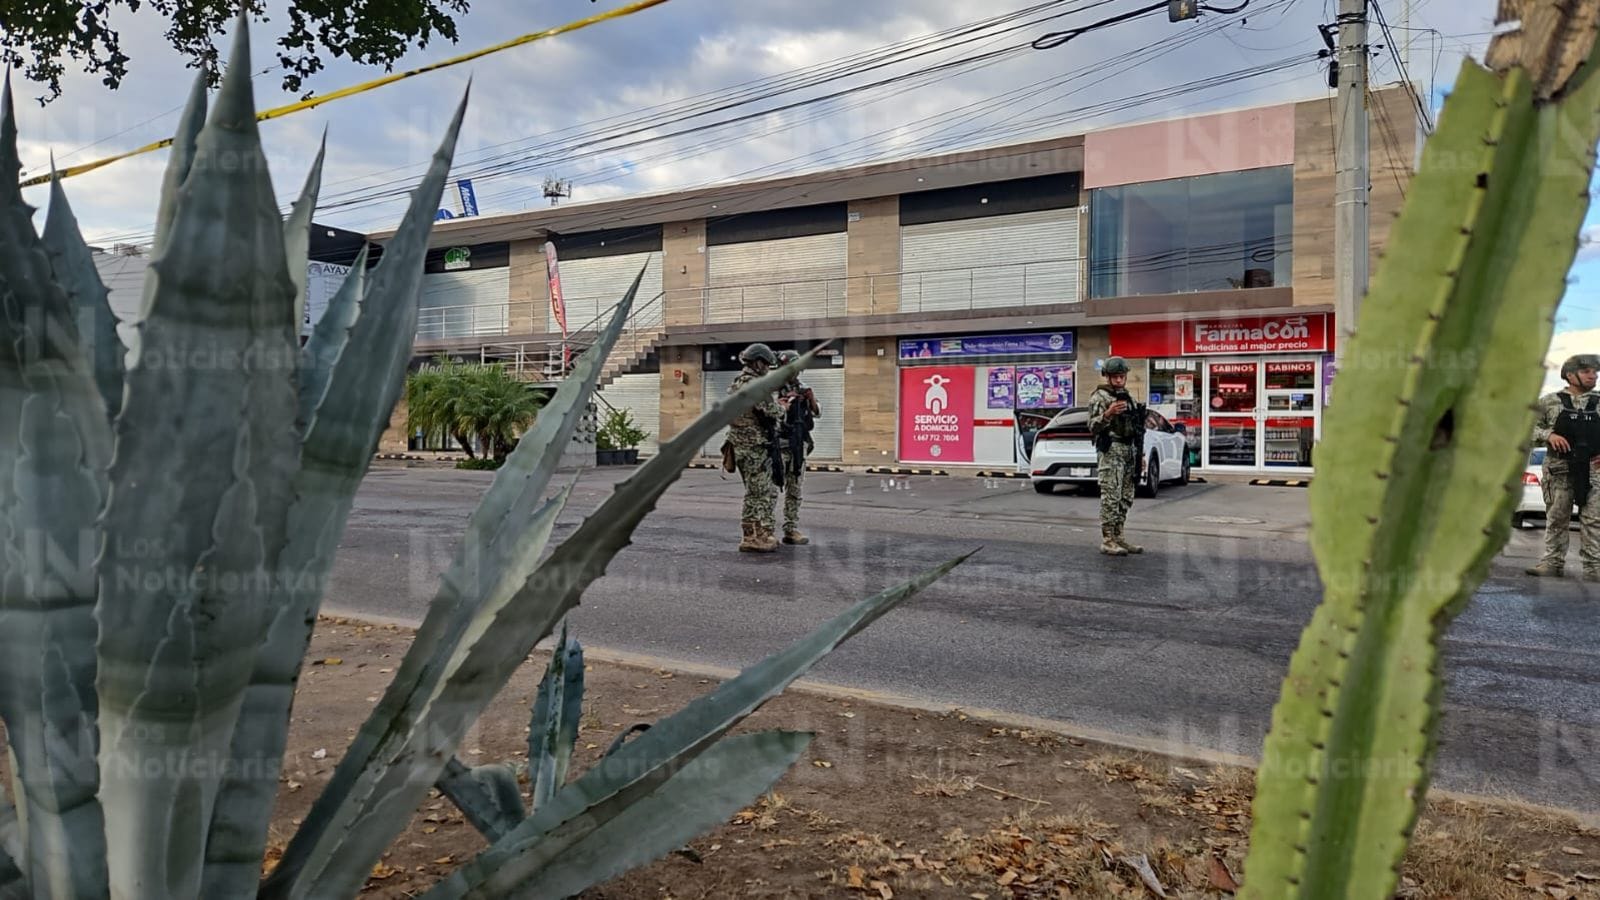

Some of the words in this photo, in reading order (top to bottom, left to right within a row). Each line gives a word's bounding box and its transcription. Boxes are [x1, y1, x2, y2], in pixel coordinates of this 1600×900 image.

[1195, 342, 1239, 351] Medicinas
[1240, 342, 1248, 350] al
[1250, 342, 1276, 351] mejor
[1278, 340, 1308, 350] precio
[1212, 364, 1254, 373] SABINOS
[1268, 363, 1311, 372] SABINOS
[914, 415, 958, 424] SERVICIO
[921, 424, 959, 432] DOMICILIO
